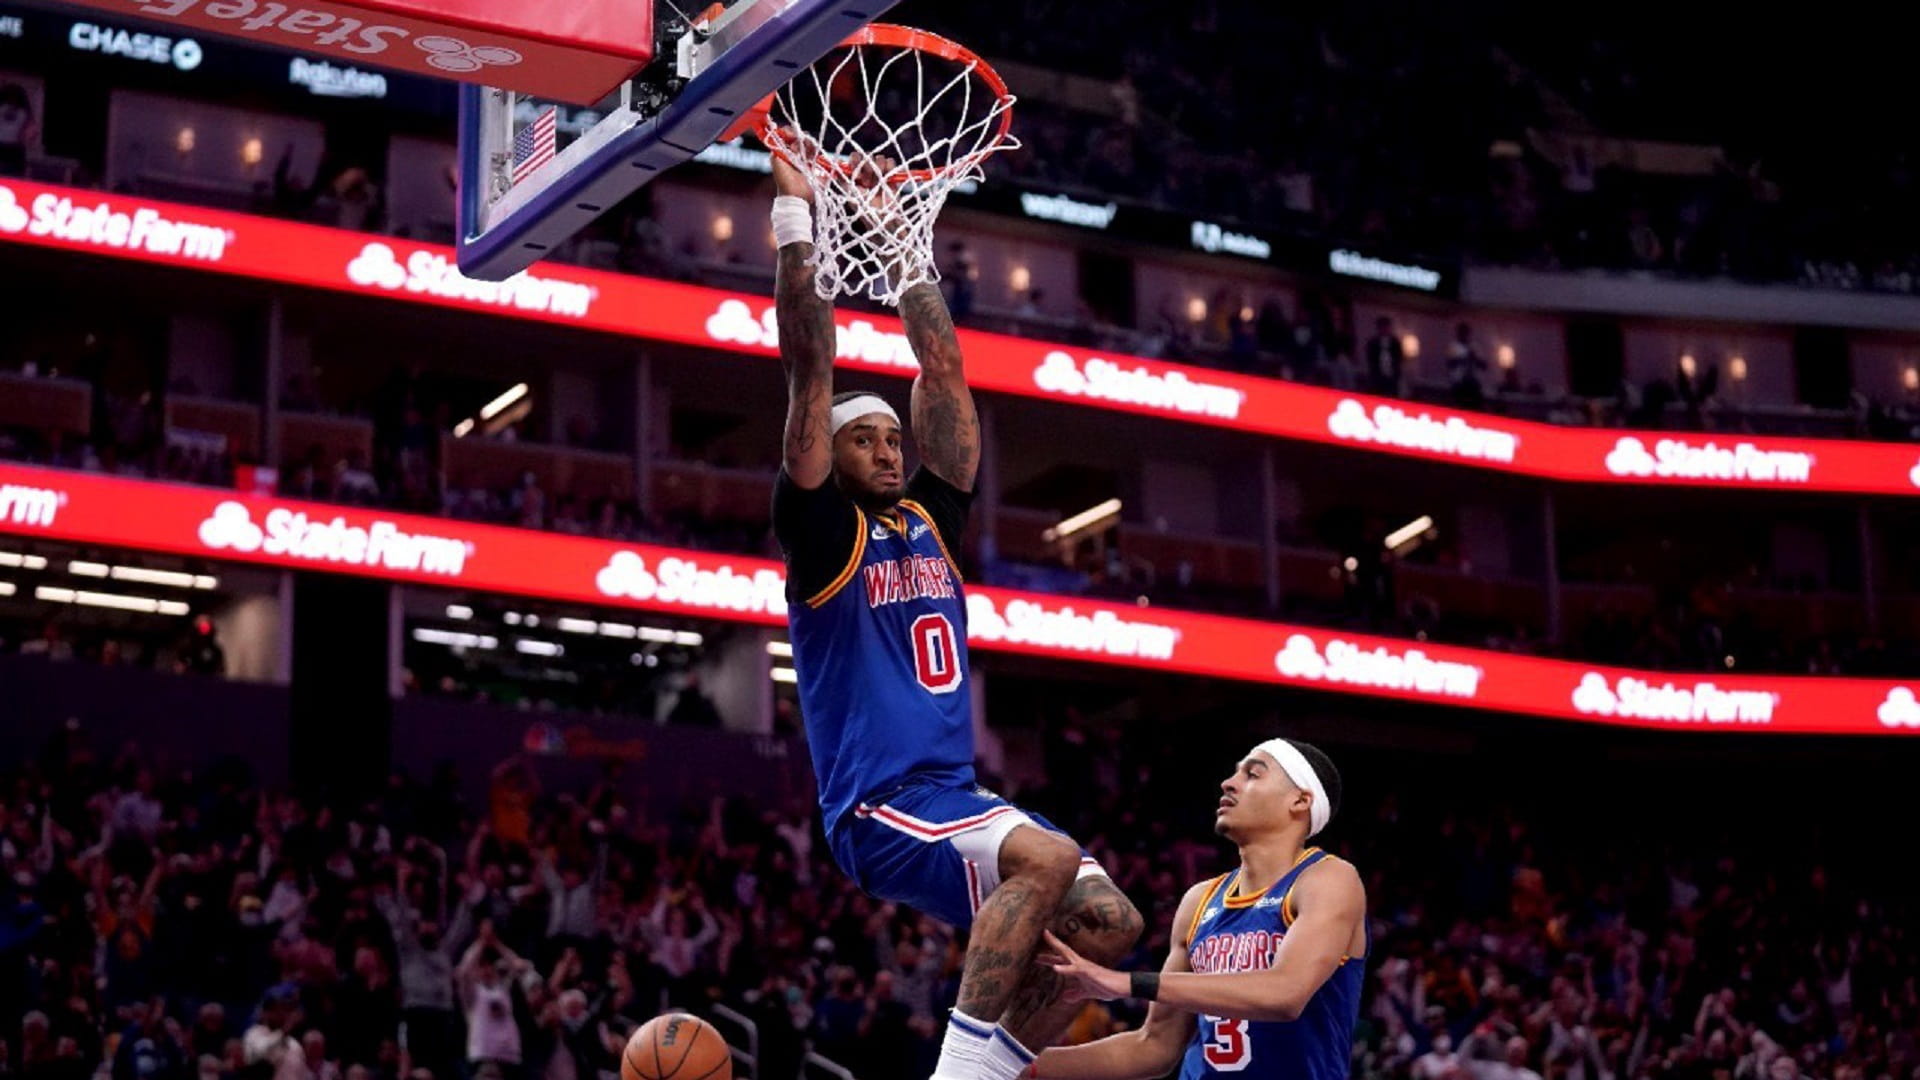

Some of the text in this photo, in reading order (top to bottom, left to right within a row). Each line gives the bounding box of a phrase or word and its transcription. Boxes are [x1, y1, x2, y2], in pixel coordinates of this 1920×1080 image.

[70, 22, 171, 63] CHASE
[910, 612, 963, 696] 0
[1203, 1014, 1252, 1072] 3
